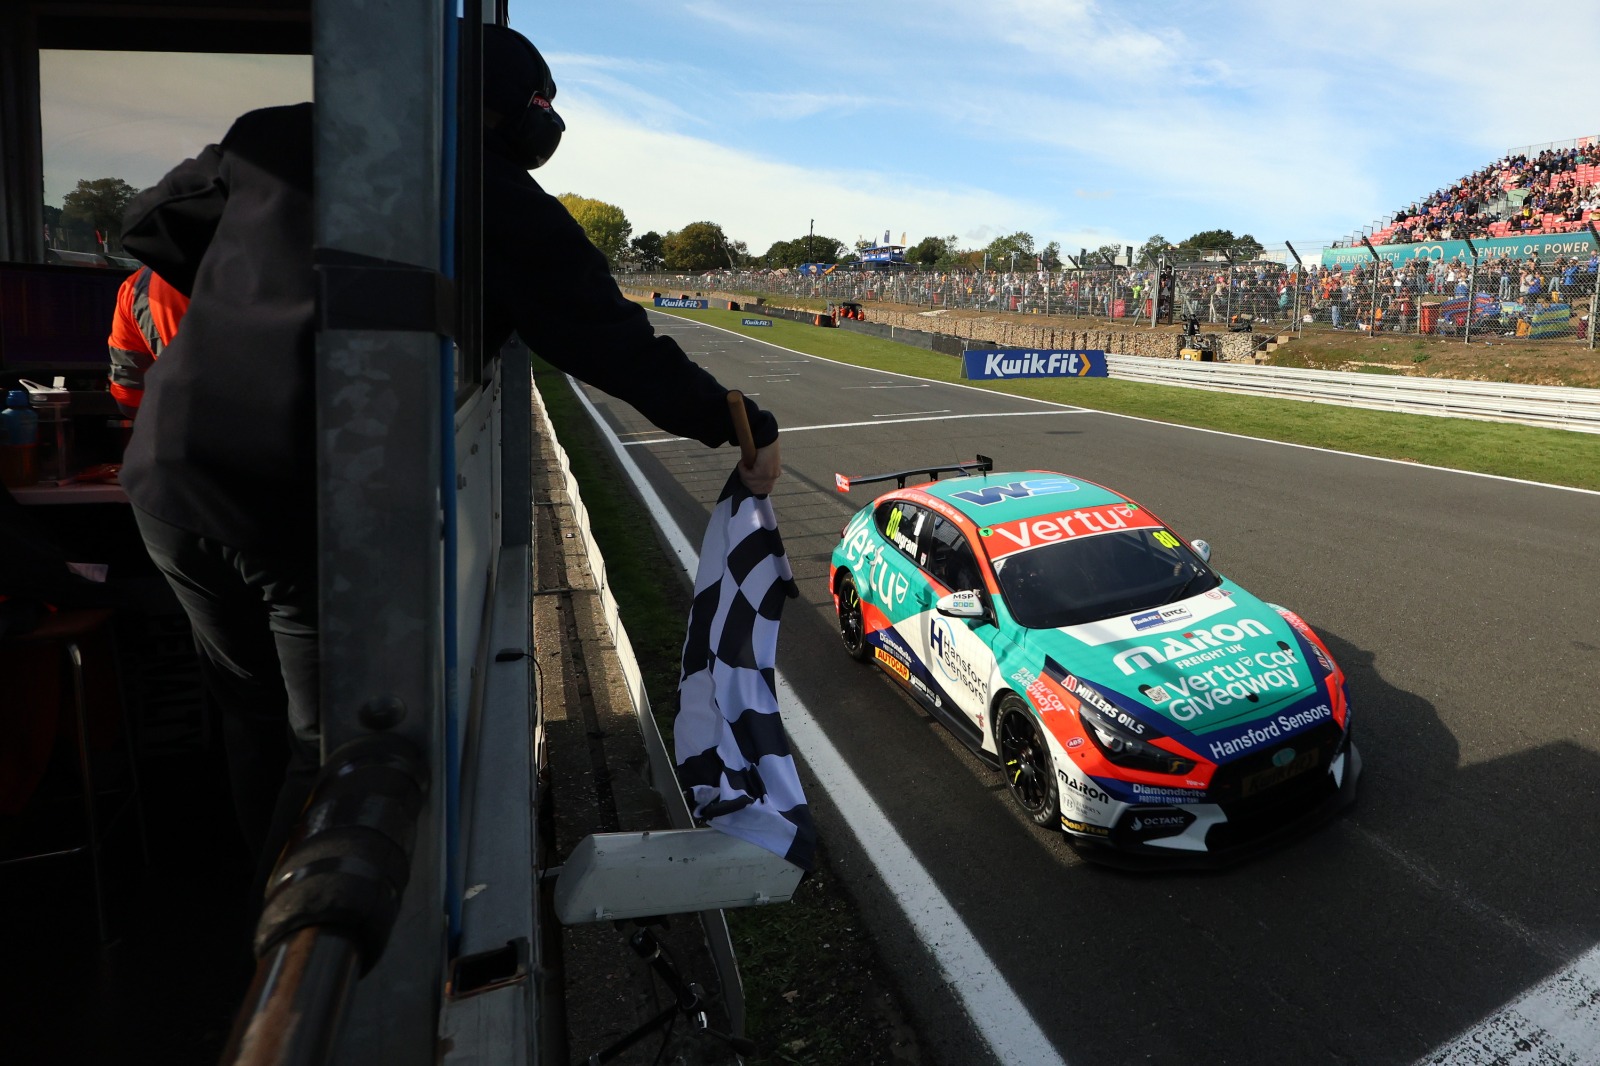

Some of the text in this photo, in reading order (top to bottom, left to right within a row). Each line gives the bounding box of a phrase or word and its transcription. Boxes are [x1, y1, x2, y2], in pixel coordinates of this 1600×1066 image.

[1336, 254, 1368, 264] BRANDS
[1459, 249, 1465, 258] A
[1523, 244, 1540, 256] OF
[1544, 242, 1589, 254] POWER
[949, 478, 1080, 507] WS
[886, 507, 902, 539] 80
[877, 649, 908, 678] AUTOCAR
[944, 636, 988, 694] Hansford
[1175, 644, 1247, 670] FREIGHT UK
[1254, 649, 1299, 669] Car
[944, 651, 985, 705] Sensors
[1047, 694, 1066, 711] Car
[1075, 683, 1145, 734] MILLERS OILS
[1209, 704, 1331, 759] Hansford Sensors
[1133, 784, 1207, 797] Diamondbrite
[1144, 816, 1185, 825] OCTANE
